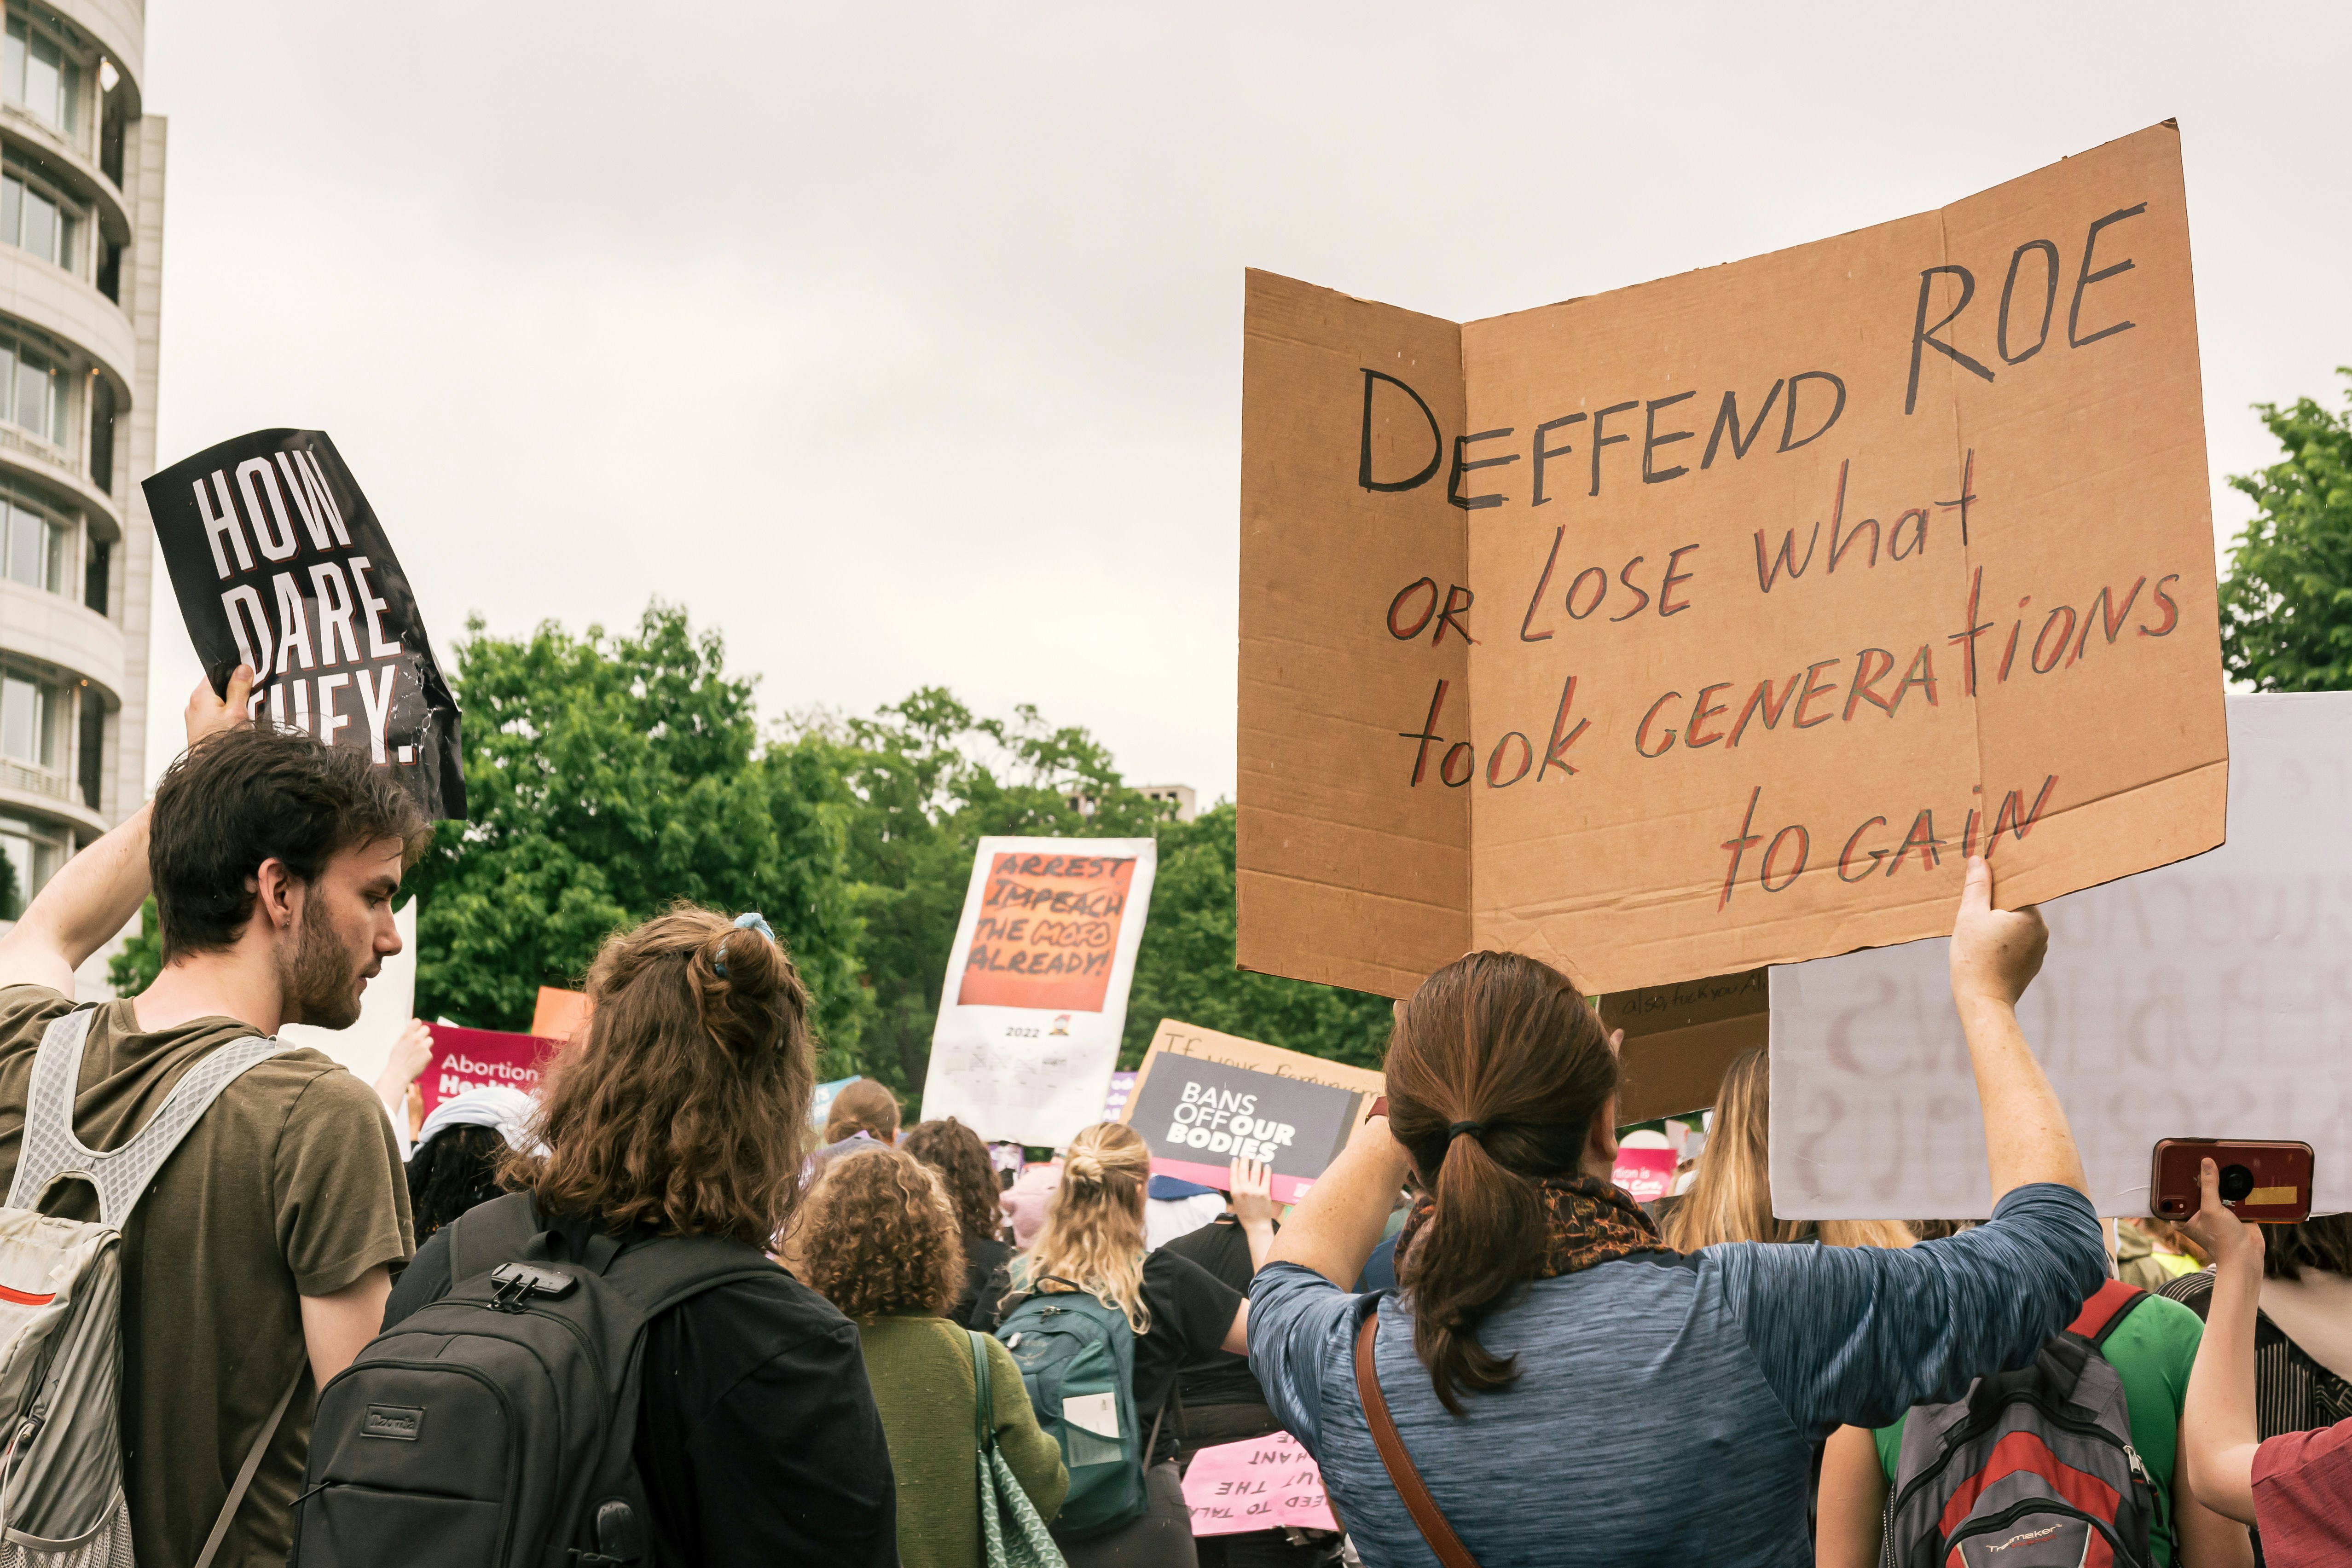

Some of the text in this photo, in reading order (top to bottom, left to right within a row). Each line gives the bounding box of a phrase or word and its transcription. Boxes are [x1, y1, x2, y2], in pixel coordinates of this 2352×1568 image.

[1359, 202, 2147, 510] DEFFEND ROE
[192, 450, 353, 580] HOW
[1387, 577, 1482, 647] OR
[1520, 525, 1700, 642] LOSE
[221, 556, 402, 689] DARE
[995, 855, 1135, 878] ARREST
[986, 879, 1124, 917] IMPEACH
[976, 918, 1111, 947] THE MOFO
[966, 944, 1110, 976] ALREADY!
[1006, 1027, 1040, 1038] 2022
[441, 1053, 539, 1082] Abortion
[1181, 1082, 1258, 1115] BANS
[1174, 1103, 1296, 1146] OFF OUR
[1166, 1122, 1279, 1163] BODIES
[1248, 1451, 1312, 1465] HANT
[1215, 1481, 1268, 1495] THE
[1285, 1494, 1329, 1508] EED
[1246, 1500, 1272, 1515] TO
